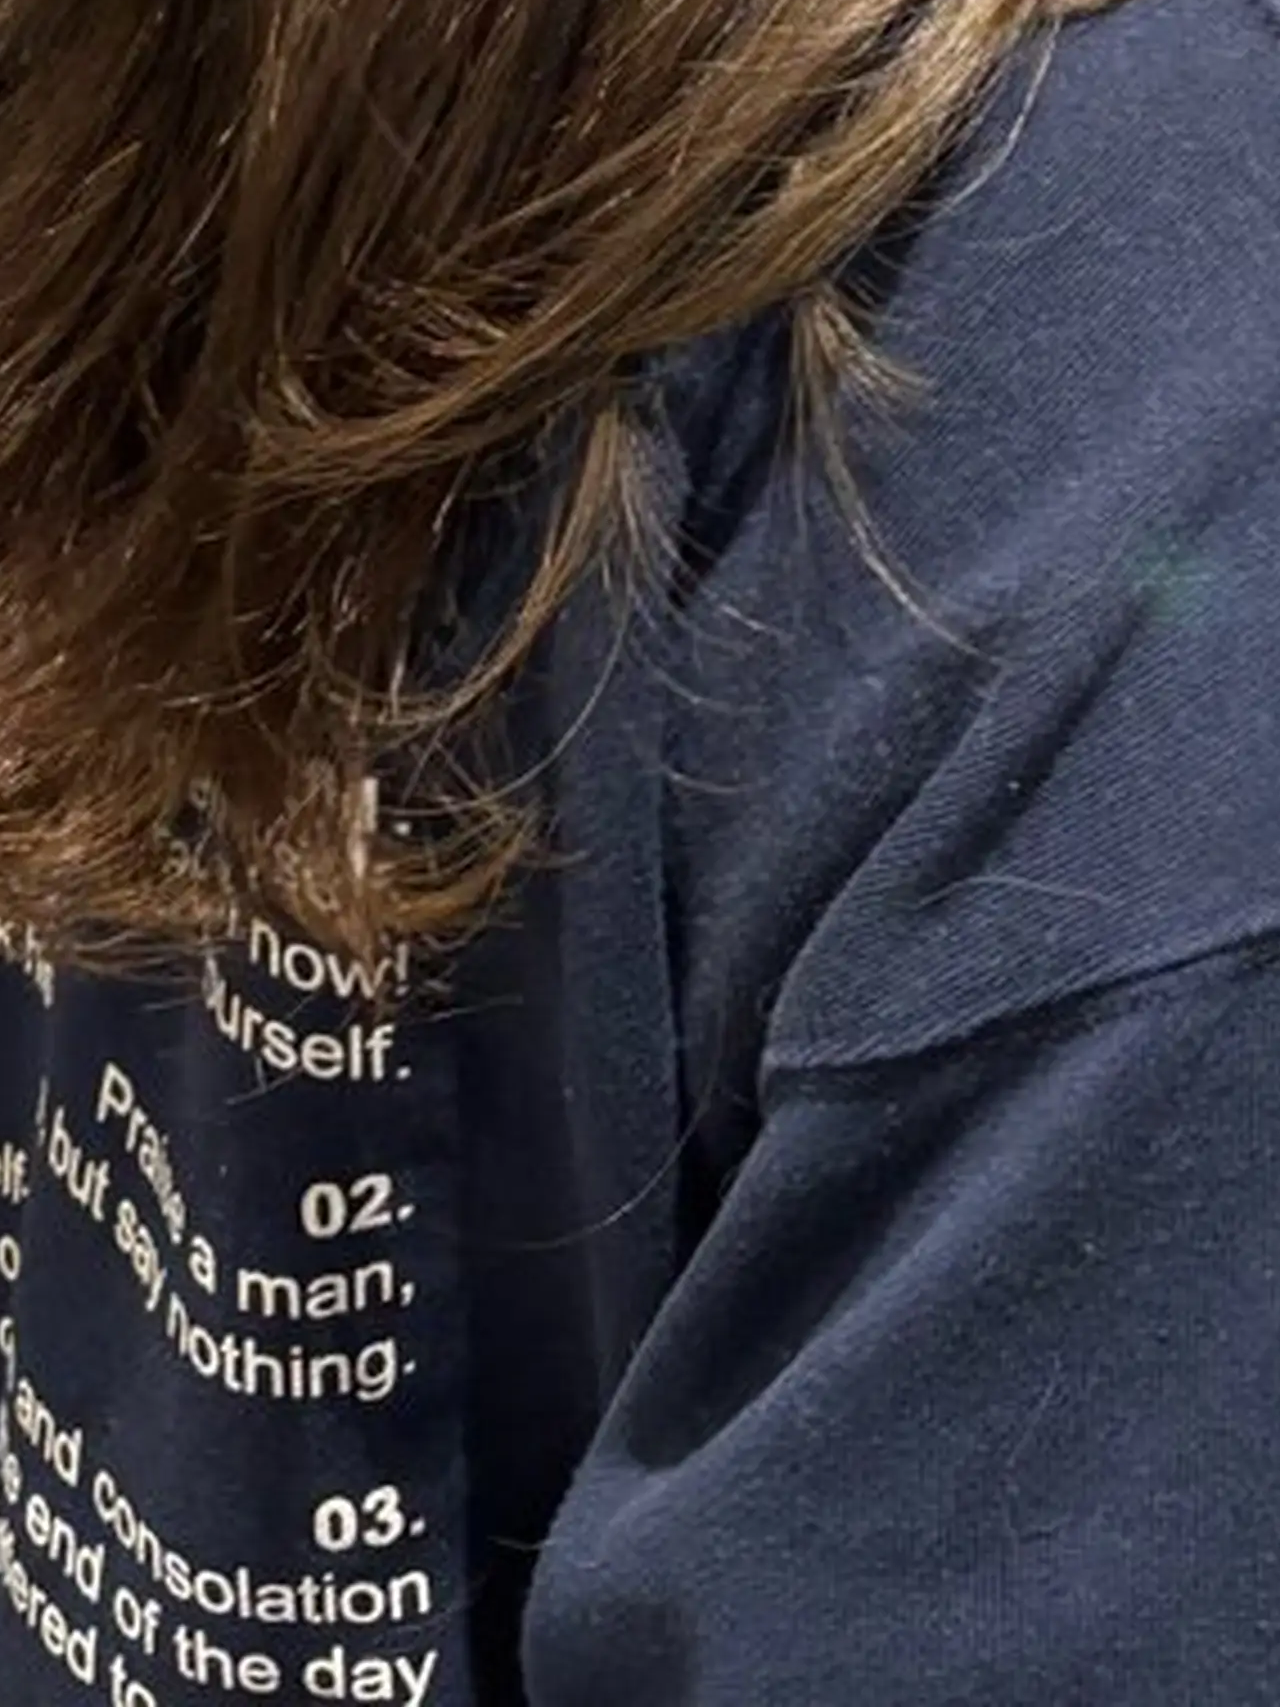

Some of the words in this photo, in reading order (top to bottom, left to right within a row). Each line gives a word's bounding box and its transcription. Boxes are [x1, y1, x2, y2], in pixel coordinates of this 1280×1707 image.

[48, 1106, 110, 1222] but
[114, 1198, 168, 1312] say
[166, 1292, 416, 1402] nothing.
[188, 1235, 218, 1293] a
[237, 1260, 415, 1320] man,
[301, 1173, 416, 1238] 02.
[14, 1377, 83, 1487] and
[92, 1470, 432, 1625] consolation
[313, 1484, 426, 1552] 03.
[25, 1493, 106, 1604] end
[114, 1586, 162, 1655] of
[173, 1624, 282, 1692] the
[304, 1644, 439, 1707] day
